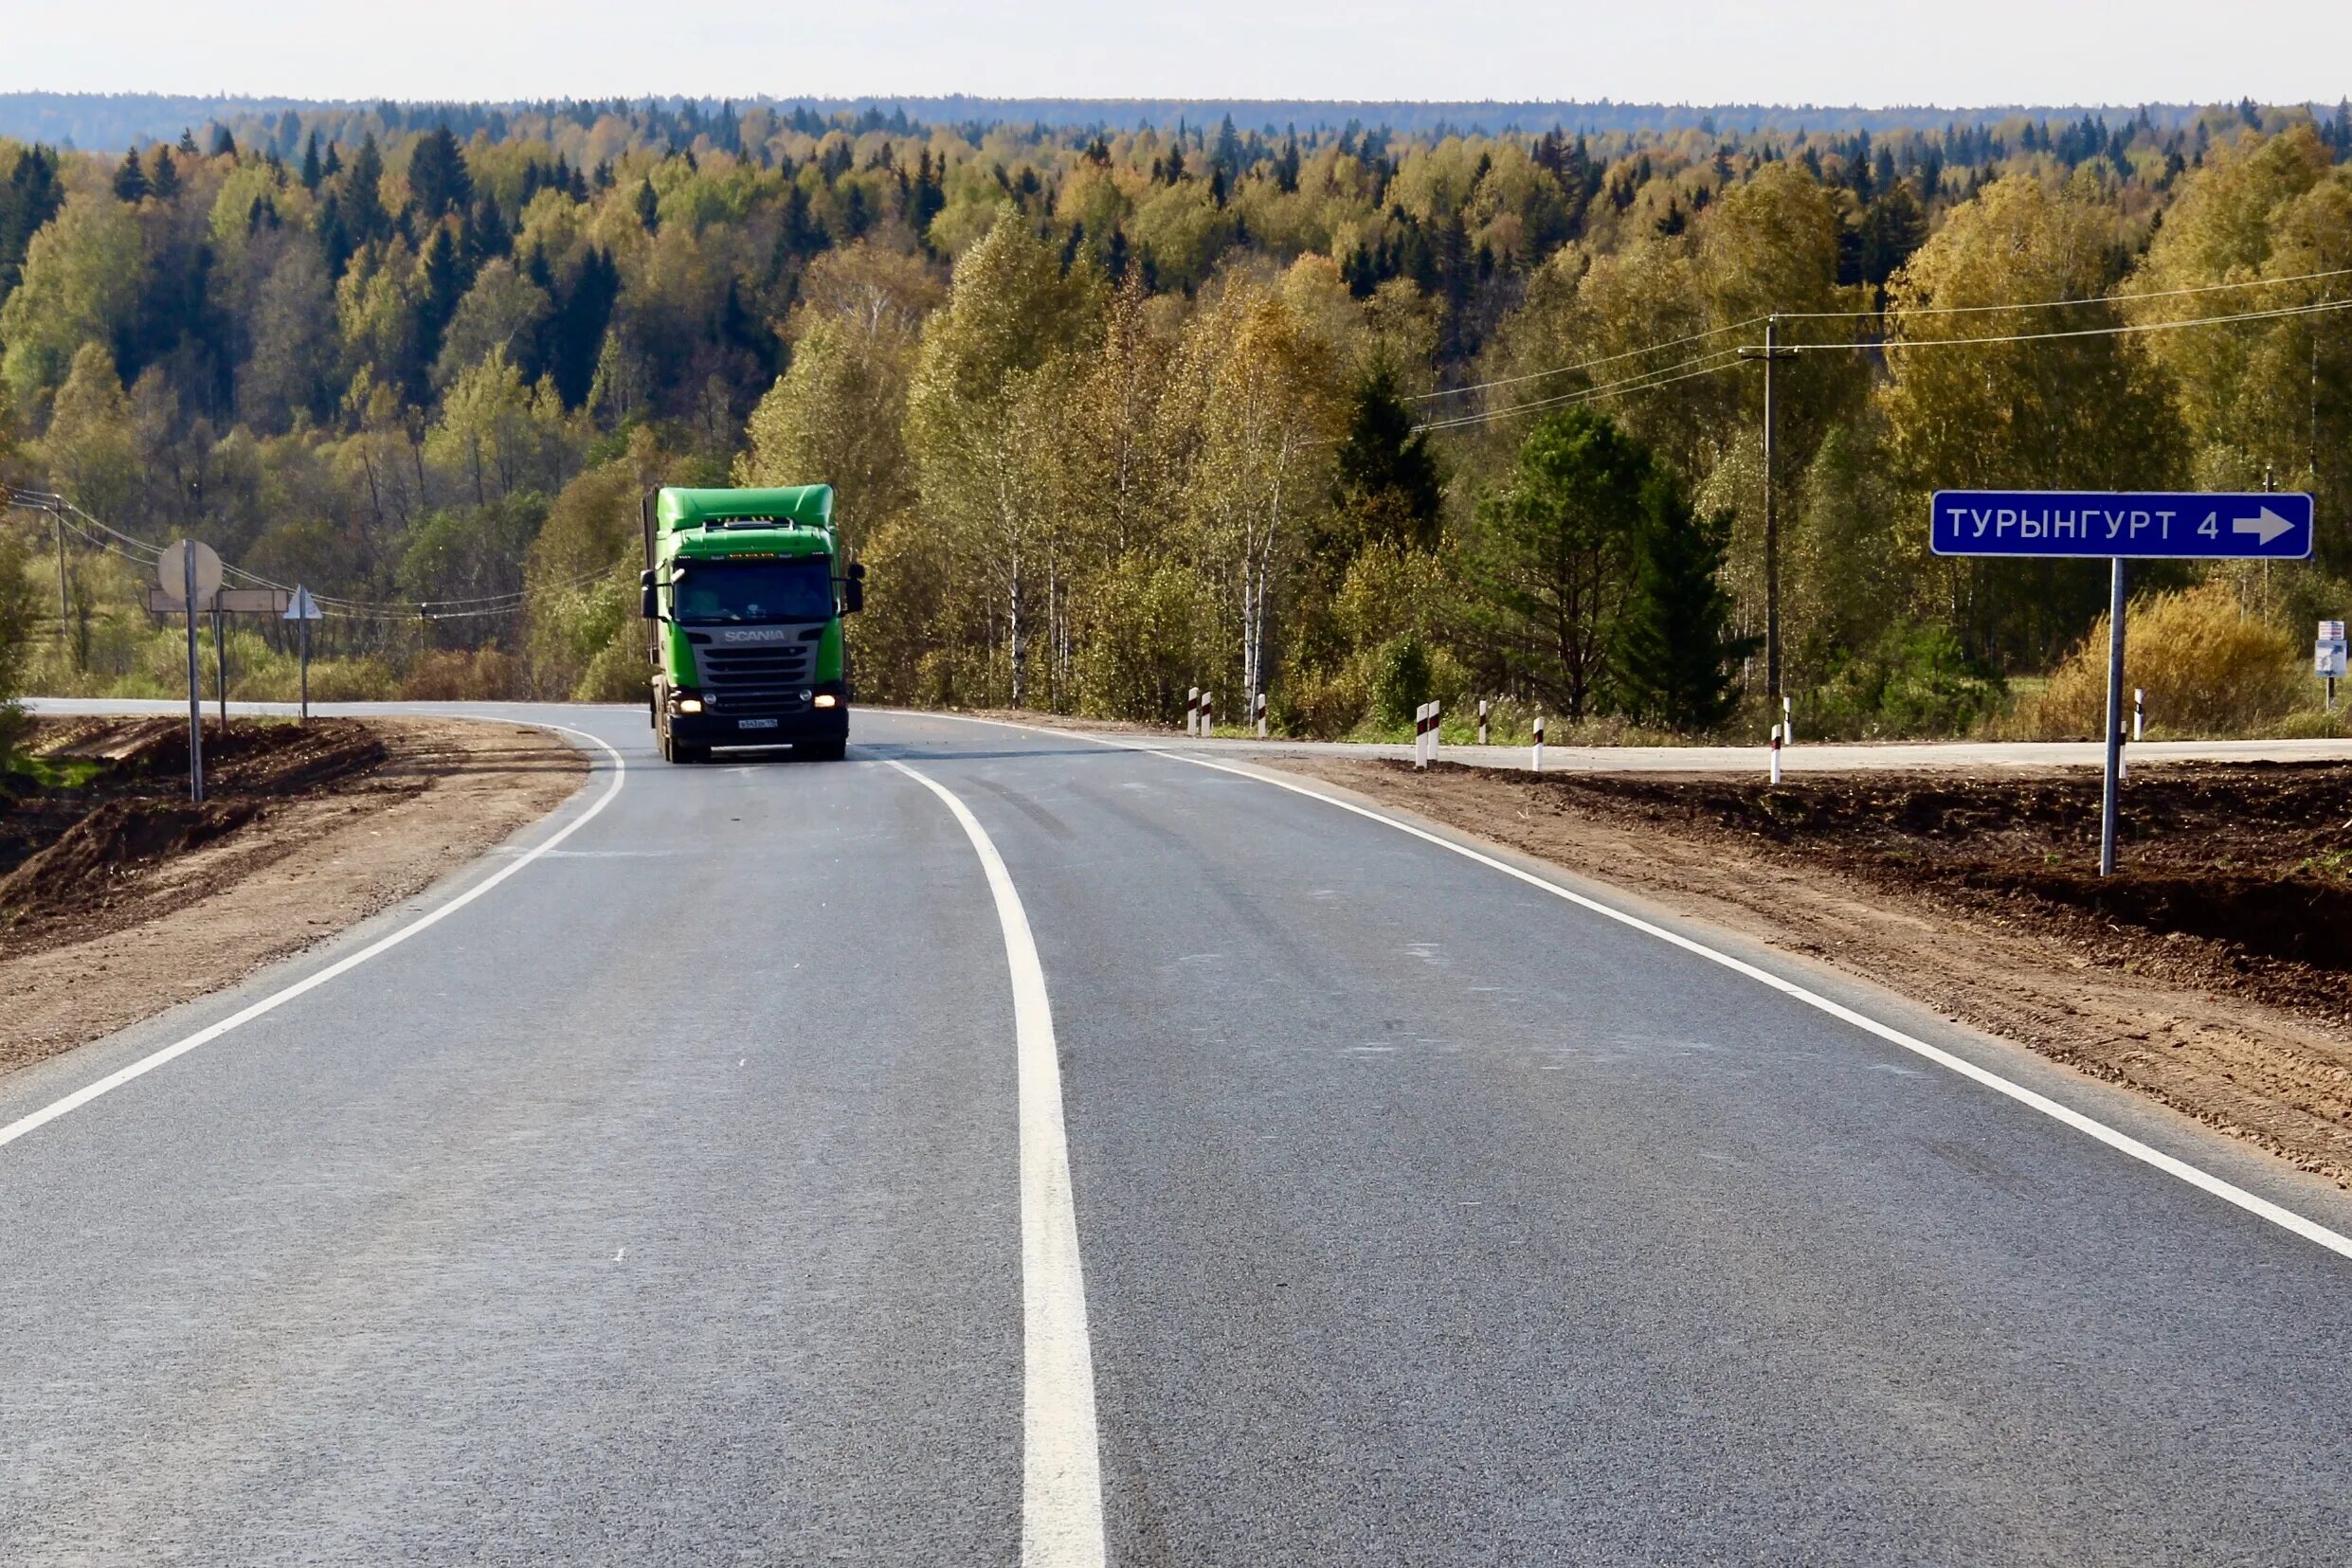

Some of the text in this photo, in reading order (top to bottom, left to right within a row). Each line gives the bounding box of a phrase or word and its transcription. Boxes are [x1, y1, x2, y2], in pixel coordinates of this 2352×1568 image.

[1946, 509, 2219, 539] ТУРЫНГУРТ 4
[725, 630, 785, 641] SCANIA
